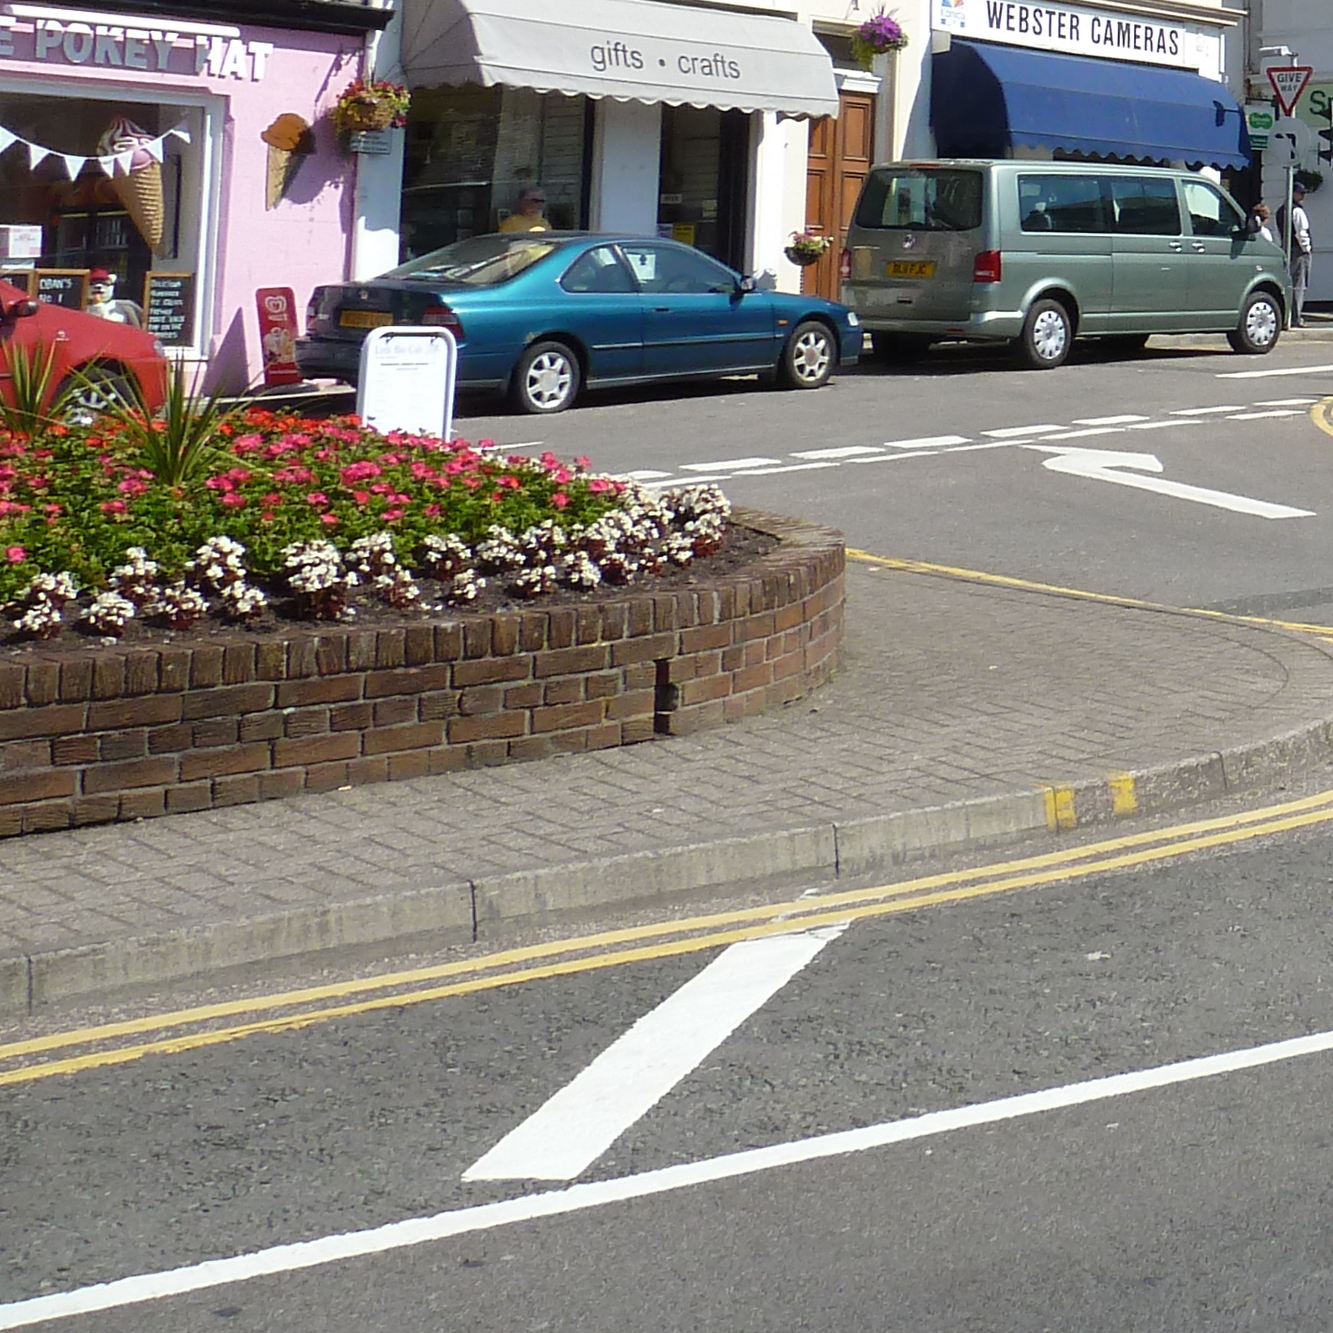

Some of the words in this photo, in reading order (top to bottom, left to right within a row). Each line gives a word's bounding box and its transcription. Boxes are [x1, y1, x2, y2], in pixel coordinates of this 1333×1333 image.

[35, 19, 179, 69] POKEY
[195, 35, 274, 83] HAT
[986, 0, 1080, 42] WEBSTER
[1091, 17, 1179, 56] CAMERAS
[590, 40, 644, 72] gifts
[677, 53, 741, 80] crafts
[1277, 73, 1302, 83] GIVE
